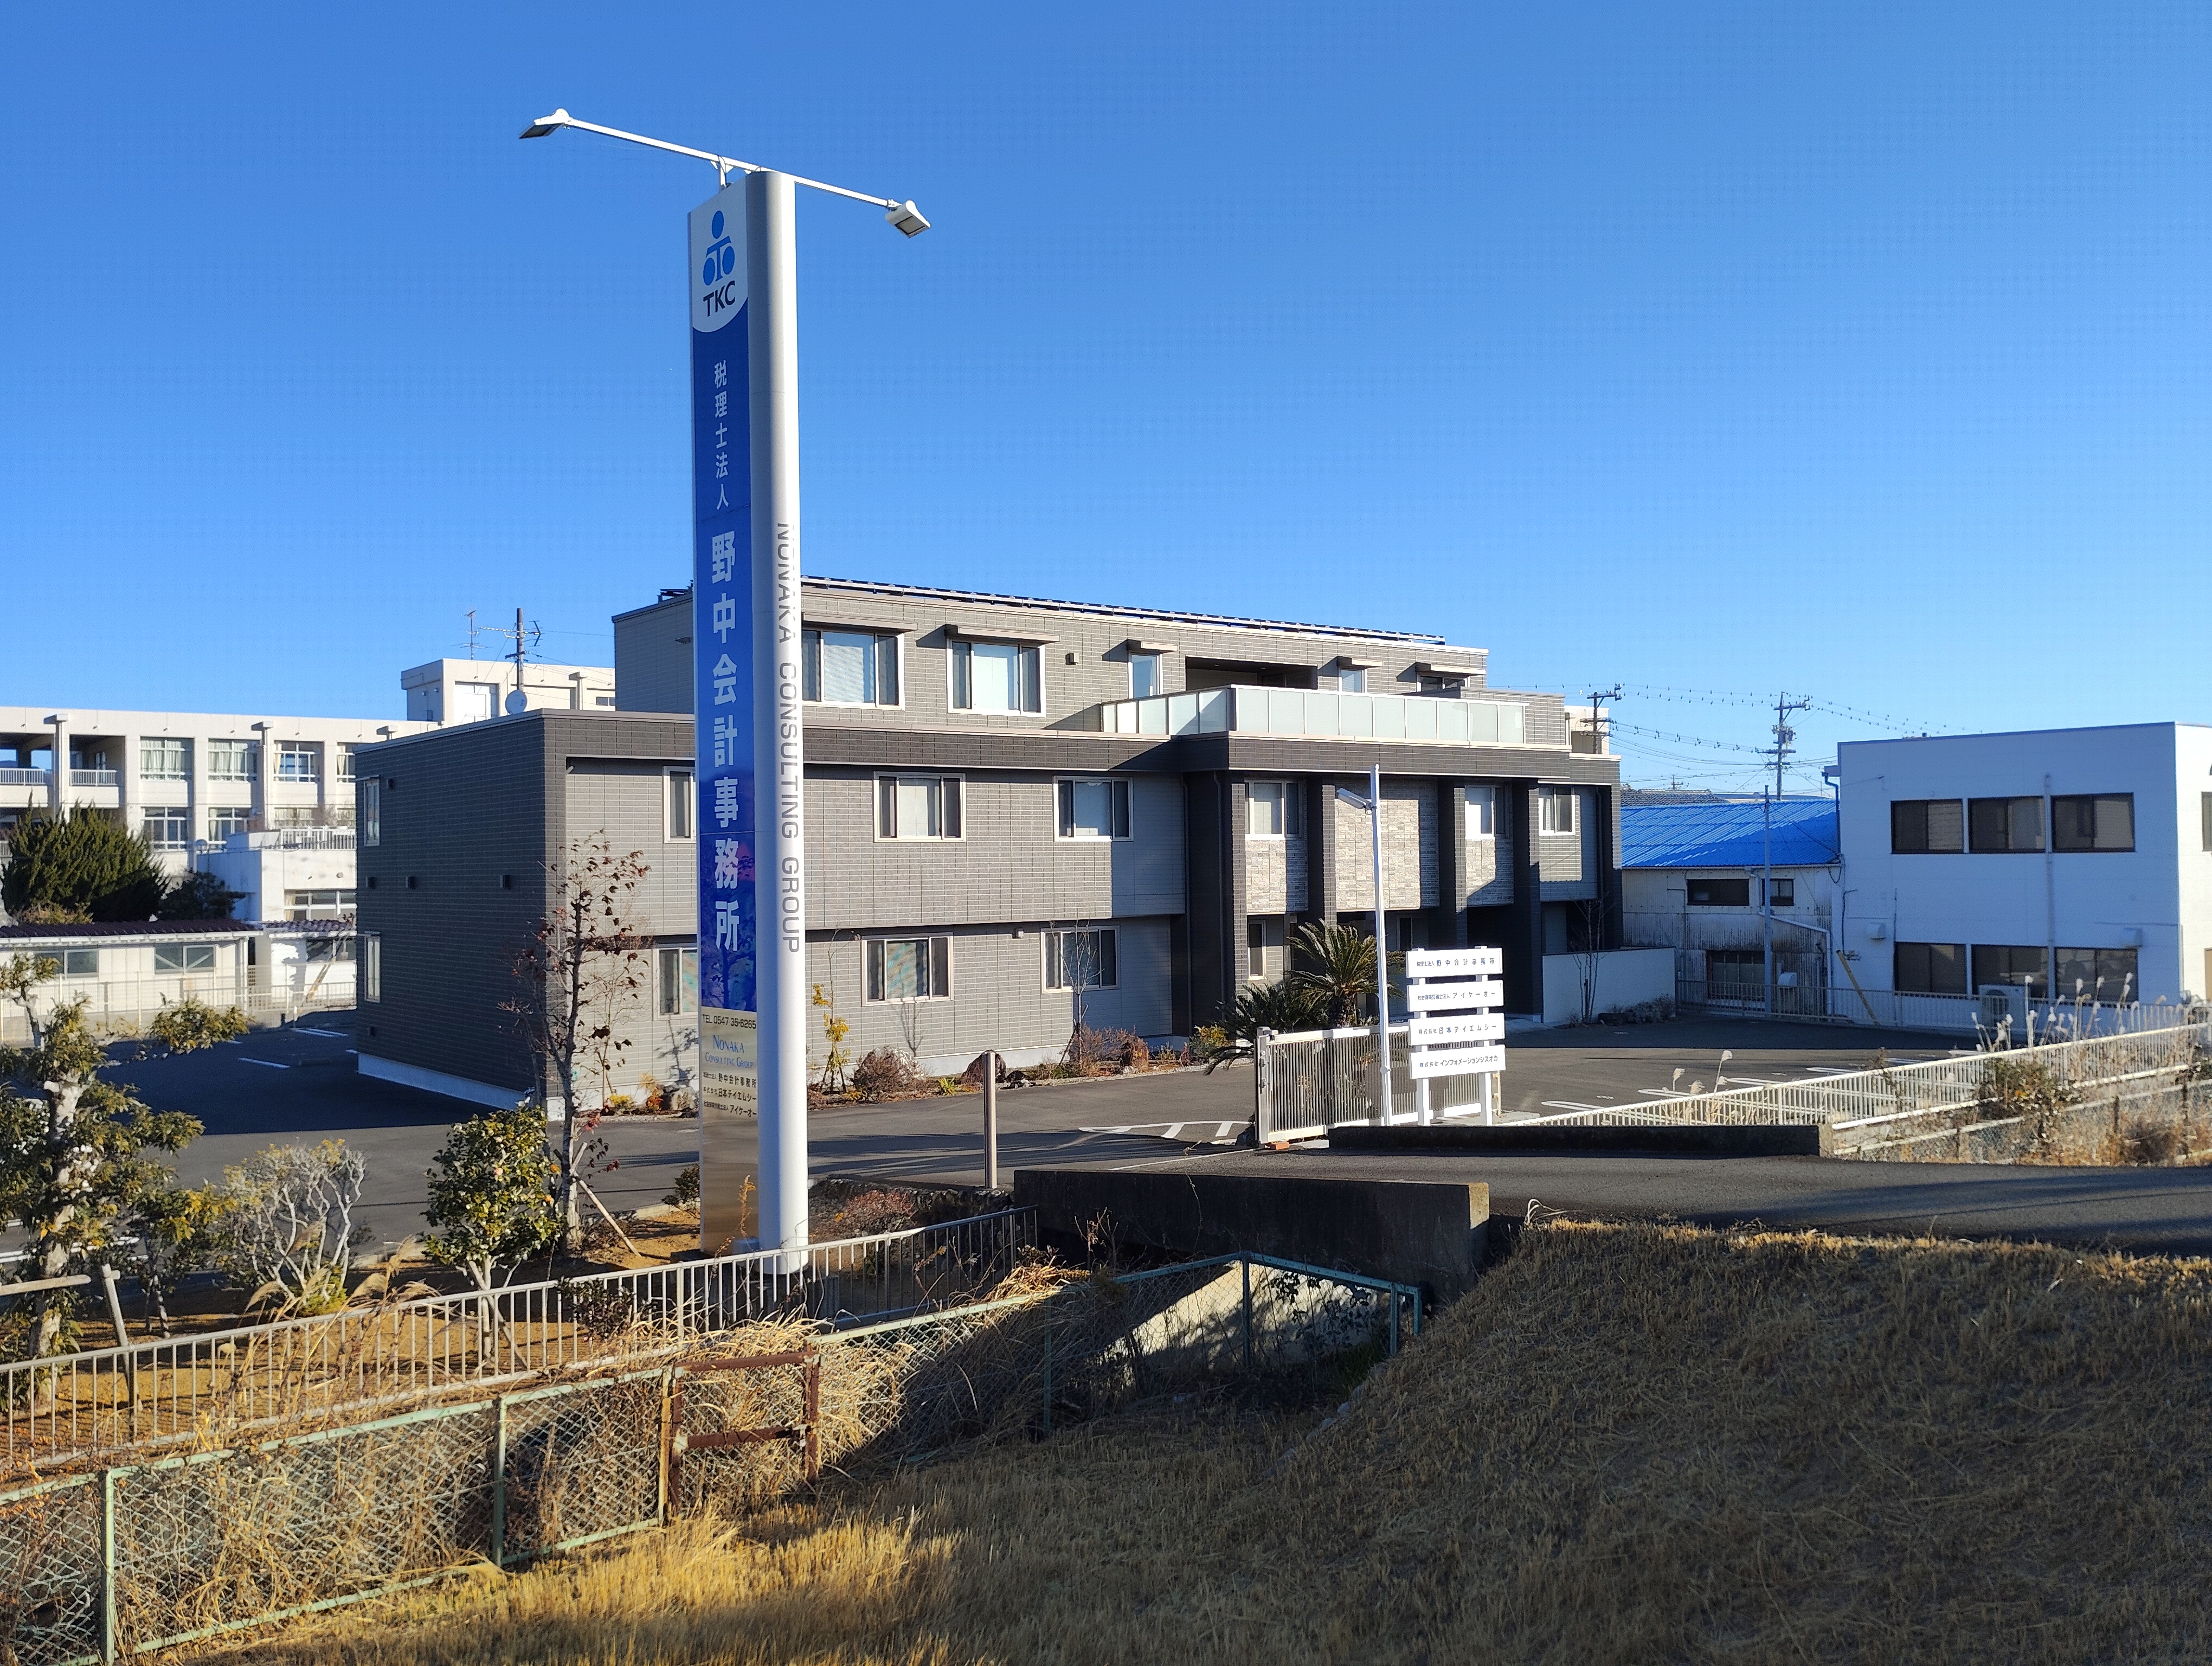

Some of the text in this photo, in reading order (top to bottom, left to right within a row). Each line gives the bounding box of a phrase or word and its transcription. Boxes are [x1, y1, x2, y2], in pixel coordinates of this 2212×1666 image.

[703, 280, 736, 318] TKC
[713, 359, 730, 511] 税理士法人
[711, 530, 741, 952] 野中会計事務所
[777, 523, 800, 953] NONAKA CONSULTING GROUP
[702, 1014, 712, 1023] TEL
[713, 1034, 745, 1054] NONAKA
